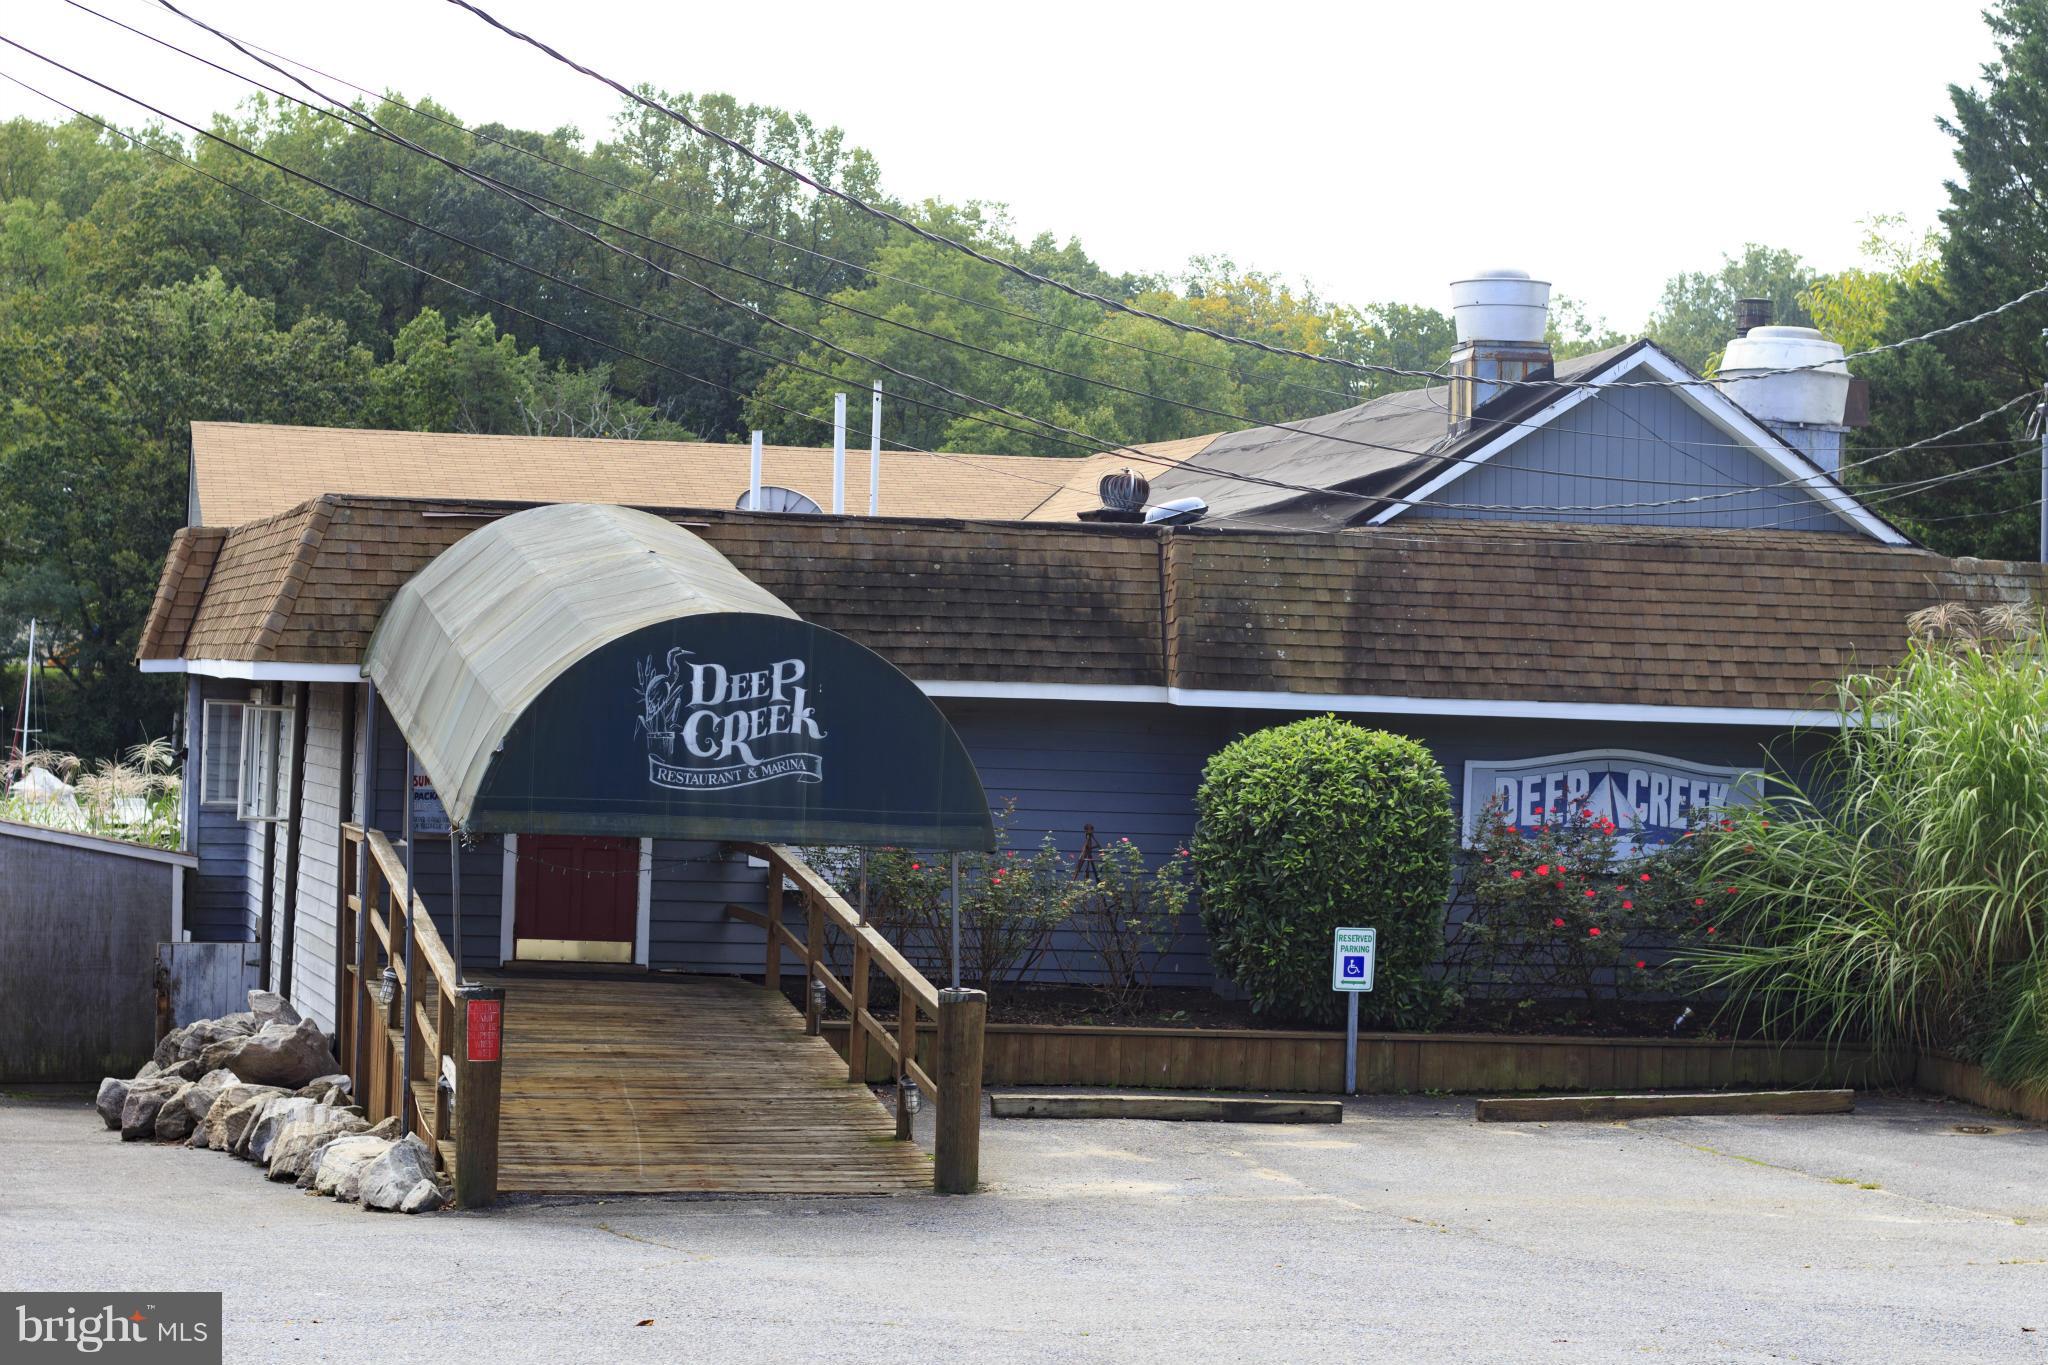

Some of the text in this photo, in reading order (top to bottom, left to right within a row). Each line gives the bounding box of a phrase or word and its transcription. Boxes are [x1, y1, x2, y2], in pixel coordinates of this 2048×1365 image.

[657, 758, 807, 786] RESTAURANT & MARINA
[1495, 769, 1730, 829] DEEP CREEK
[1338, 934, 1373, 943] RESERVED
[1340, 945, 1370, 953] PARKING
